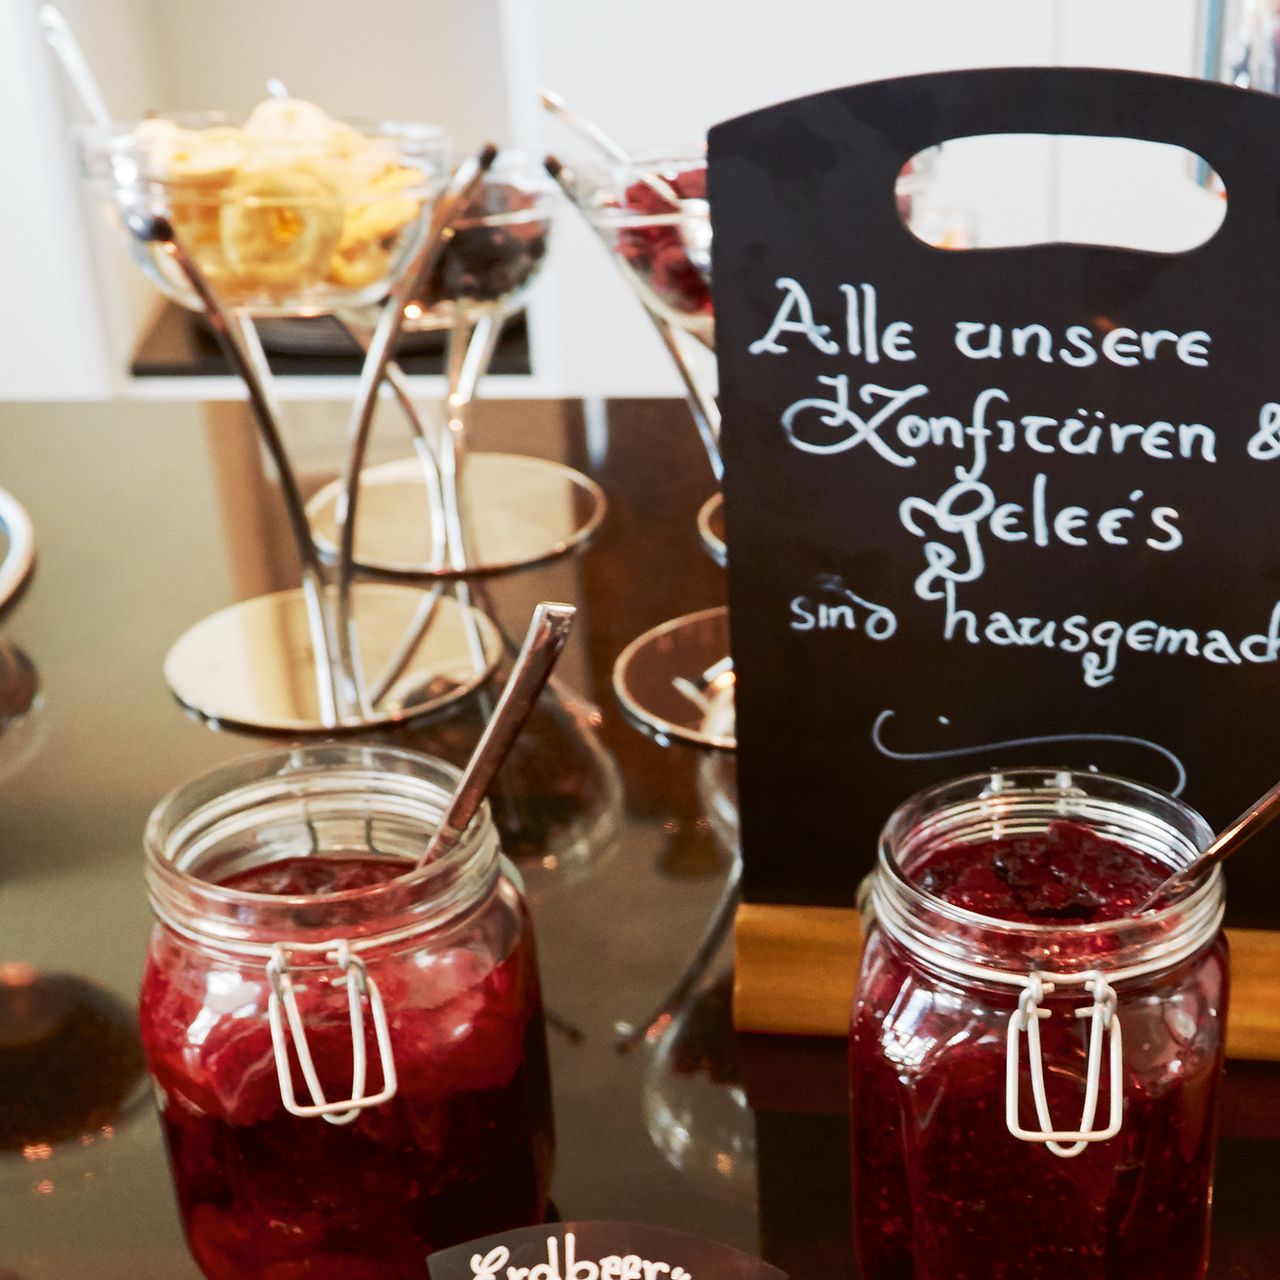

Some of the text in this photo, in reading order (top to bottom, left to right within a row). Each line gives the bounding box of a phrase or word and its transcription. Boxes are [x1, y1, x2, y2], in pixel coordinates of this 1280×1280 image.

[748, 276, 1214, 368] Alle unsere
[781, 374, 1218, 483] Konfitüren
[789, 582, 898, 641] sind
